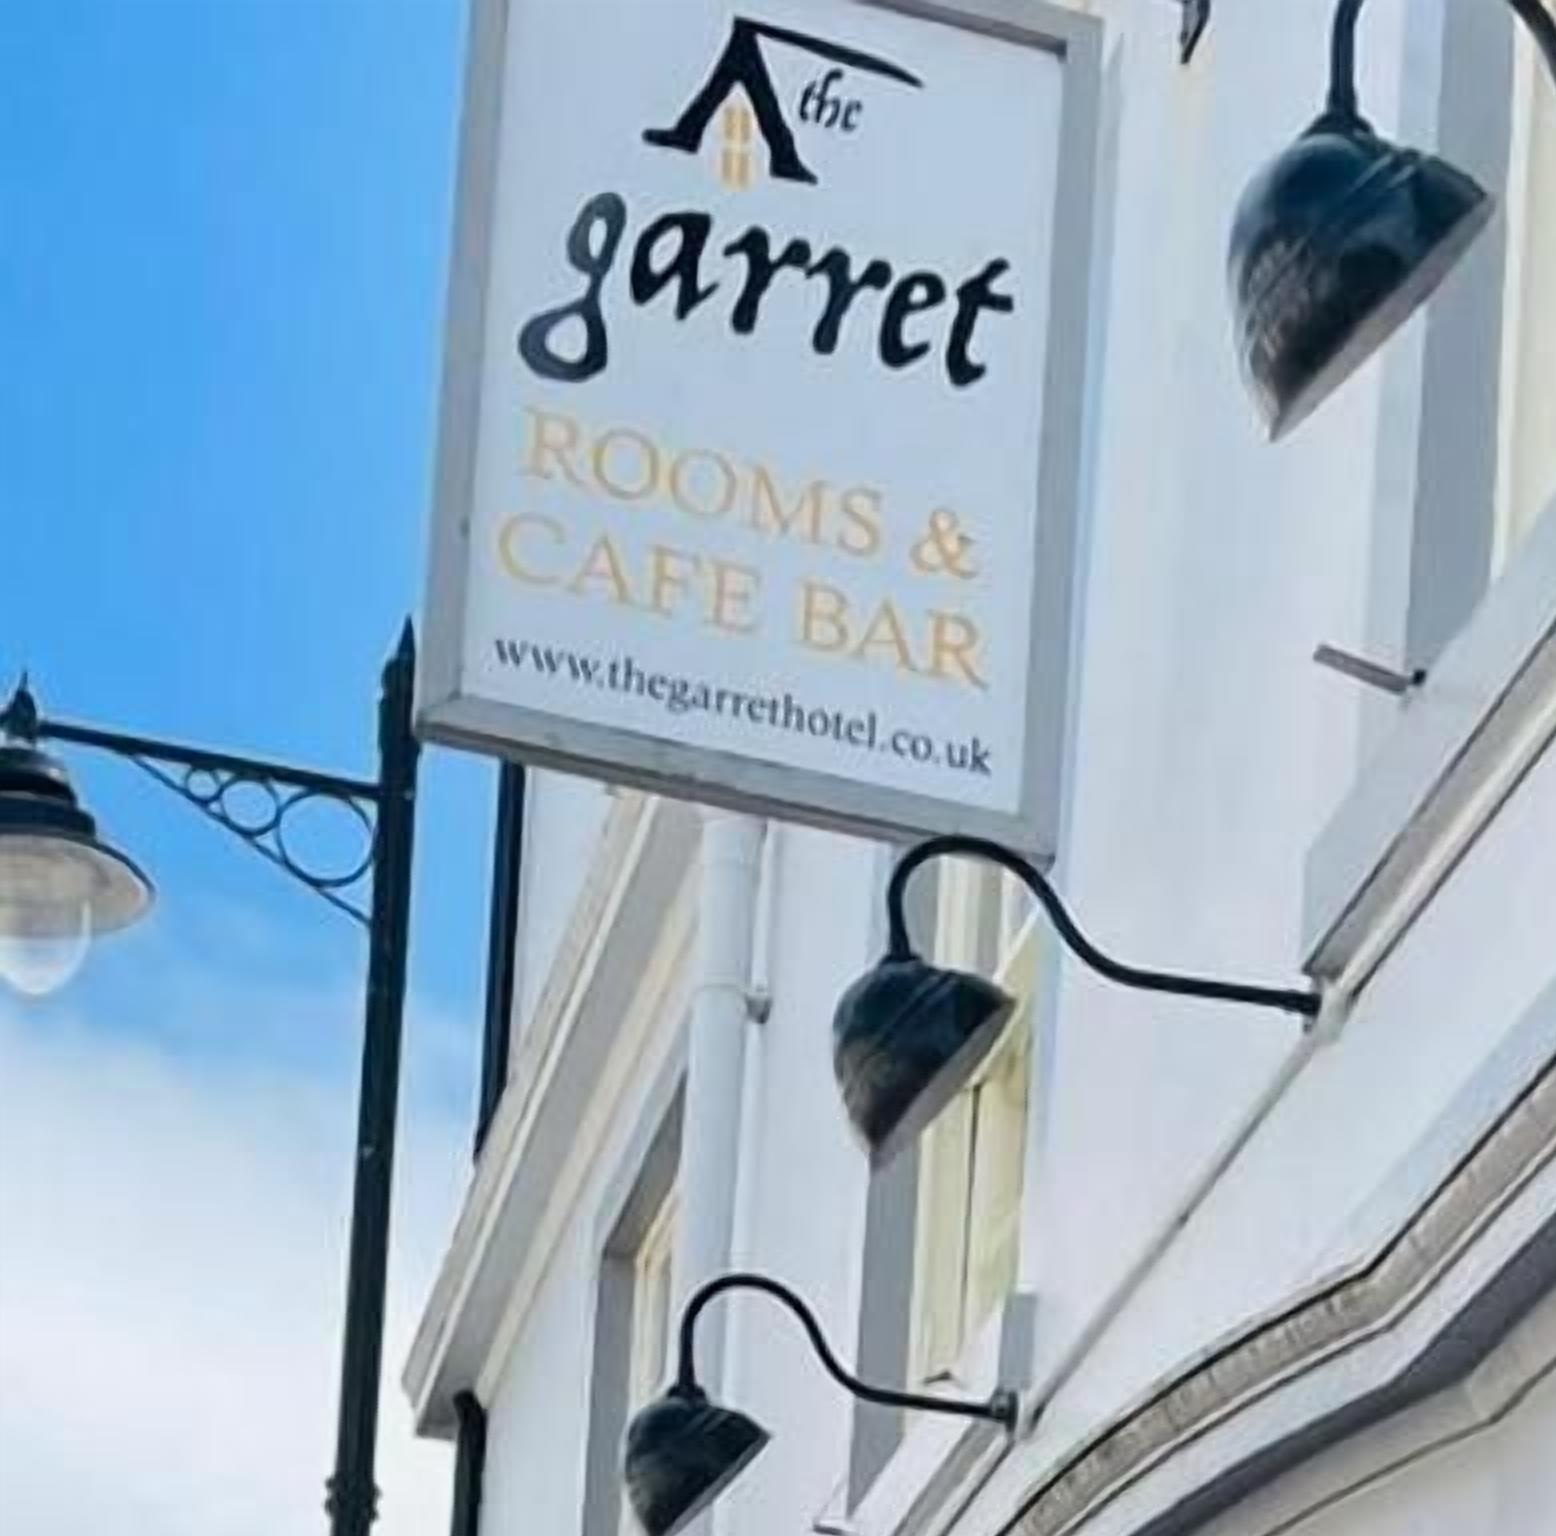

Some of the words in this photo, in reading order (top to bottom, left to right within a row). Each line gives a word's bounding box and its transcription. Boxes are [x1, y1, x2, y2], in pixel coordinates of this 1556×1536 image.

[798, 68, 863, 132] the
[517, 191, 1015, 388] garret
[521, 404, 884, 559] ROOMS
[908, 508, 979, 580] &
[497, 513, 764, 636] CAFE
[799, 580, 990, 690] BAR
[494, 635, 992, 775] www.thegarrethotel.co.uk
